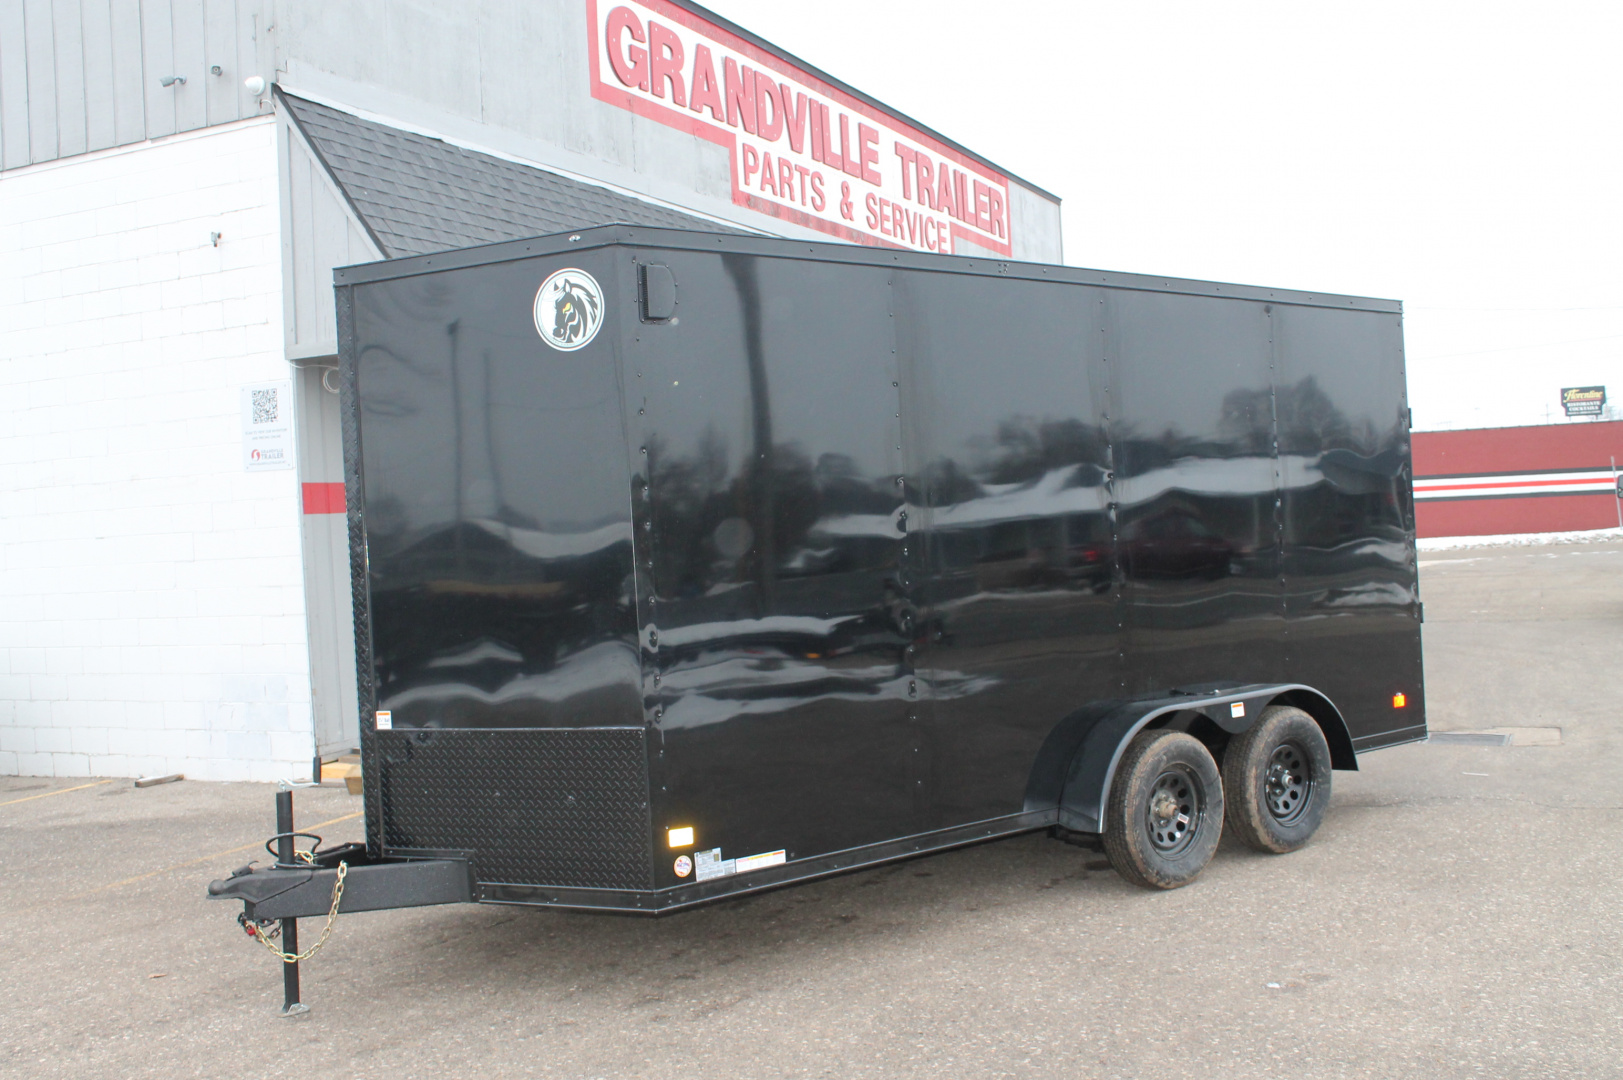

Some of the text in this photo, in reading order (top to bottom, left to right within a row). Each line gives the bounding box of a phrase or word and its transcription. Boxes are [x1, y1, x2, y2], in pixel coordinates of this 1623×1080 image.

[605, 5, 1006, 239] GRANDVILLE TRAILER
[742, 143, 949, 254] PARTS & SERVICE
[261, 452, 284, 460] TRAILER
